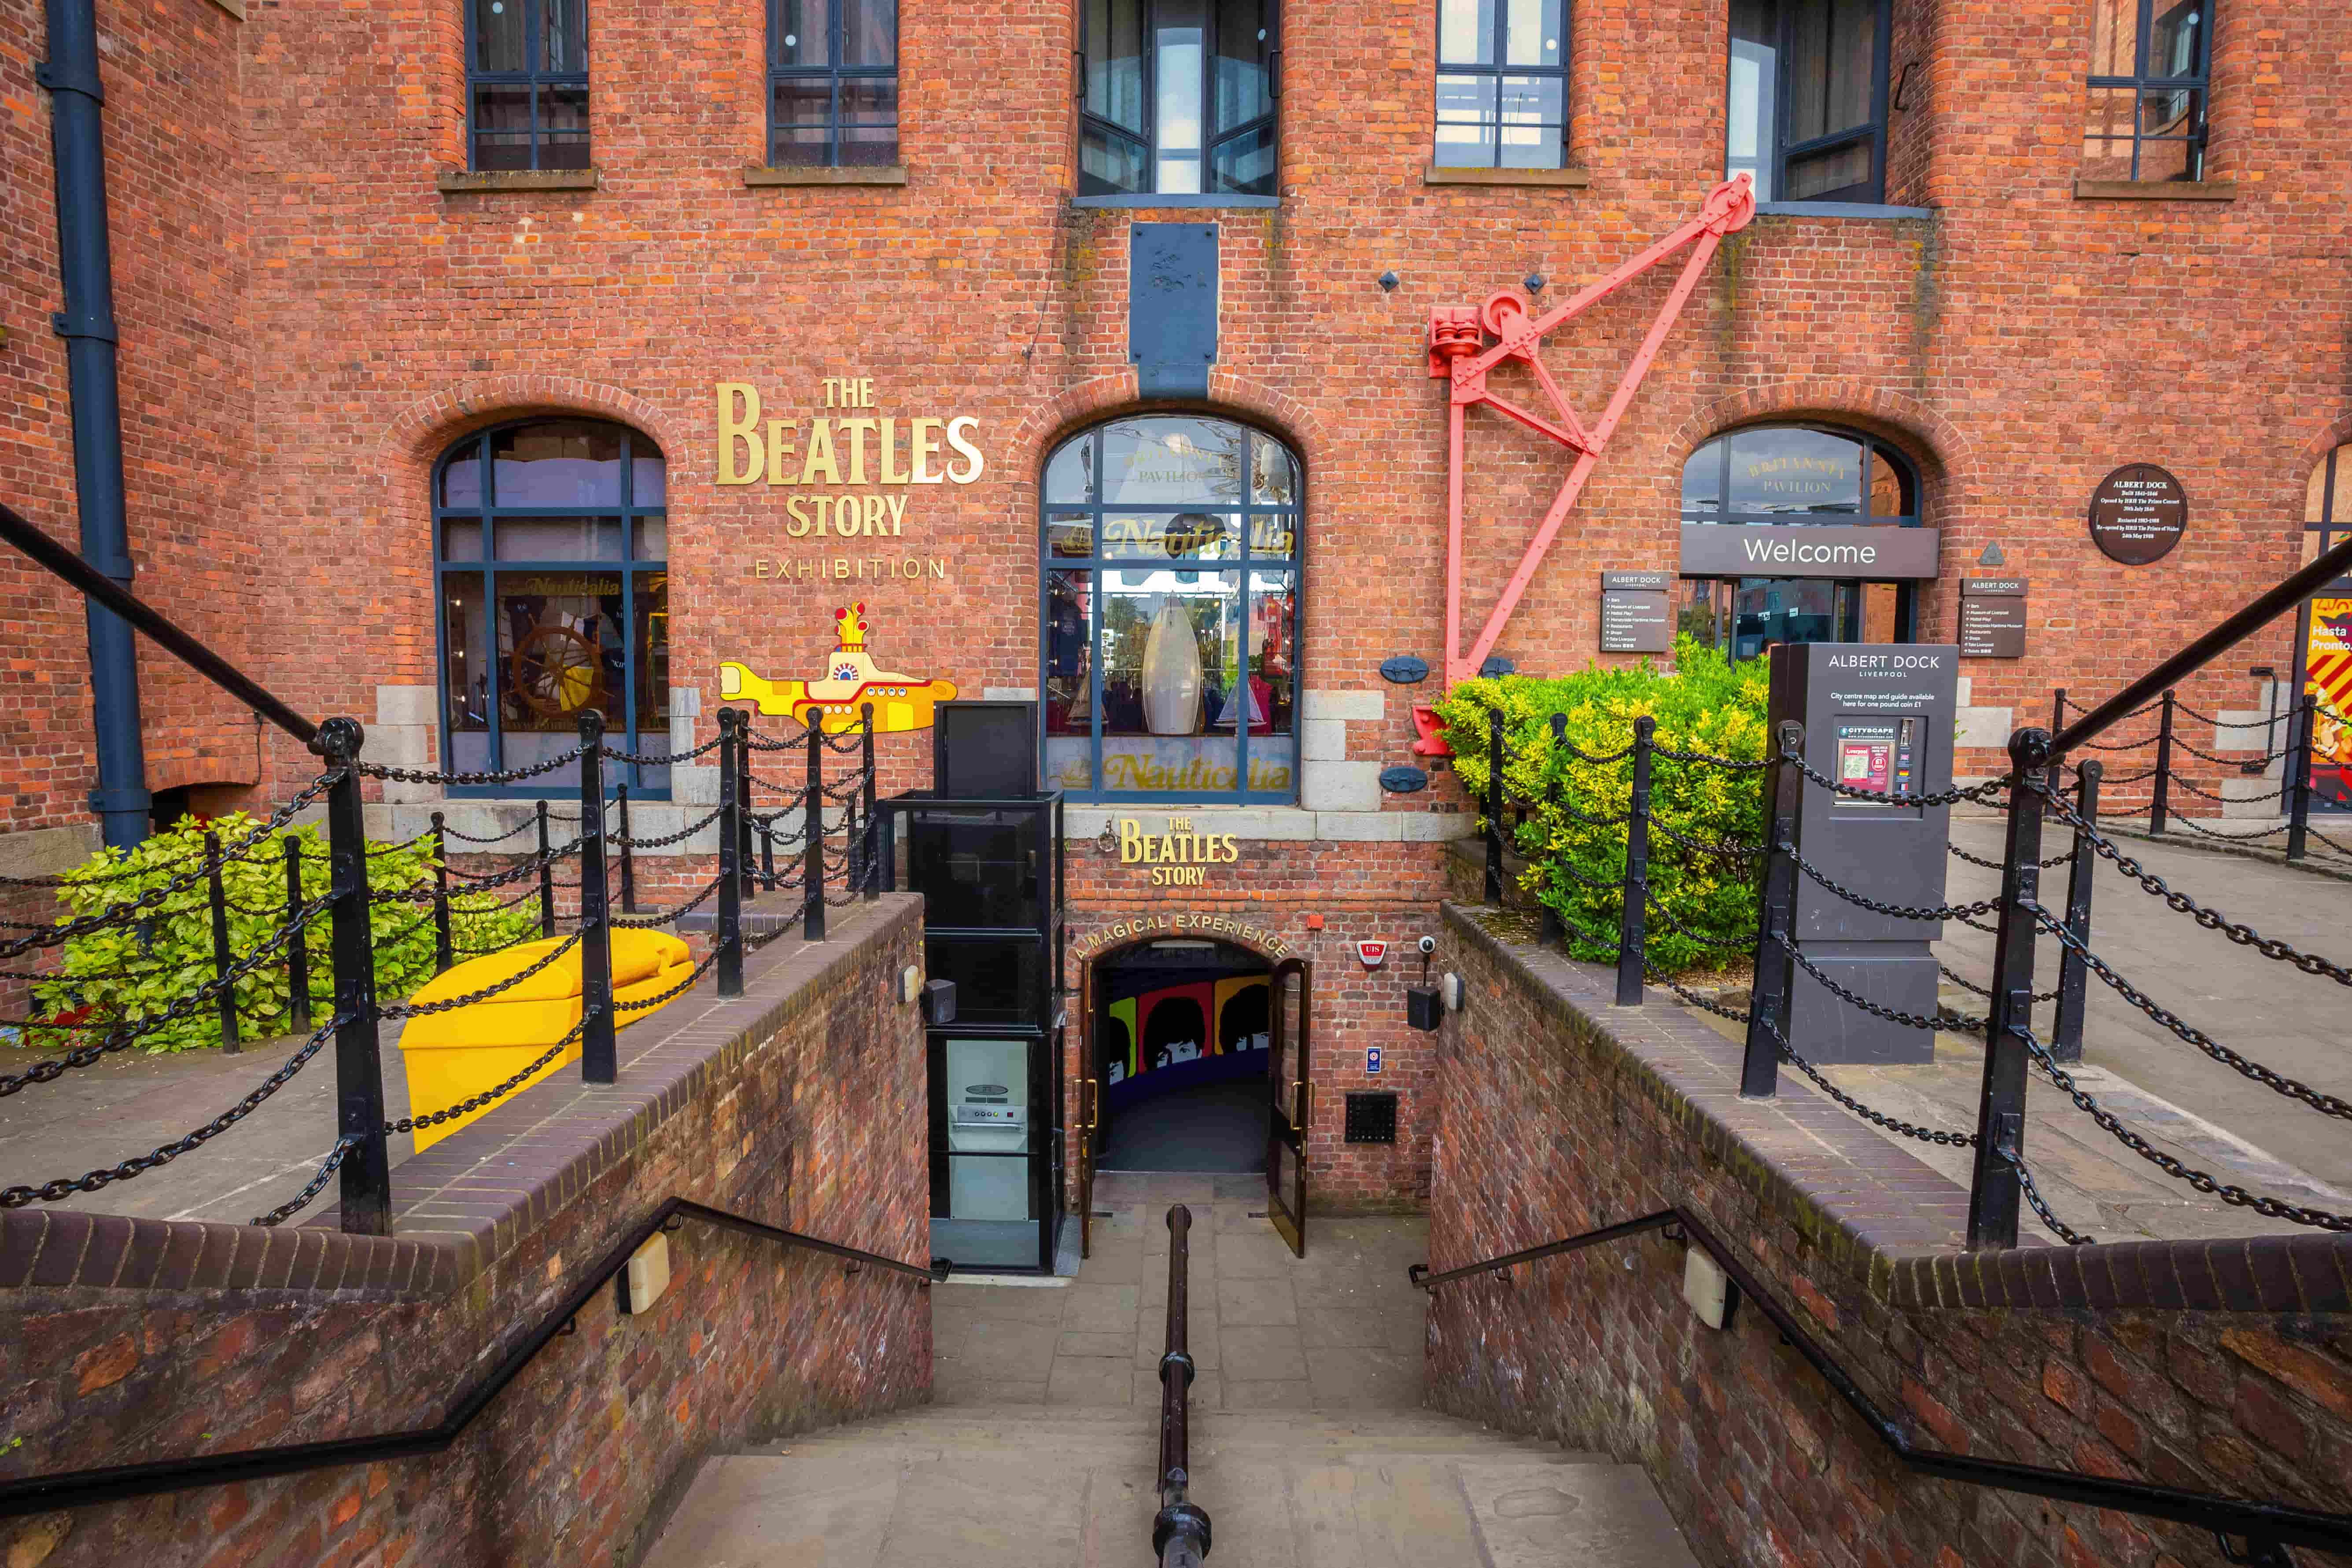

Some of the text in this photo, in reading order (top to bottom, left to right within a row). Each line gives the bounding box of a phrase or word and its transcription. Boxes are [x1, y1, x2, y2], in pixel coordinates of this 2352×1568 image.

[822, 378, 875, 408] THE
[715, 382, 984, 485] BEATLES
[786, 494, 909, 537] STORY
[1744, 538, 1876, 563] Welcome
[755, 559, 945, 579] EXHIBITION
[2313, 626, 2347, 637] Hasta
[1829, 655, 1940, 668] ALBERT DOCK
[1168, 817, 1191, 831] THE
[1120, 818, 1239, 863] BEATLES
[1152, 866, 1206, 886] STORY
[1075, 915, 1290, 960] A MAGICAL EXPERIENCE
